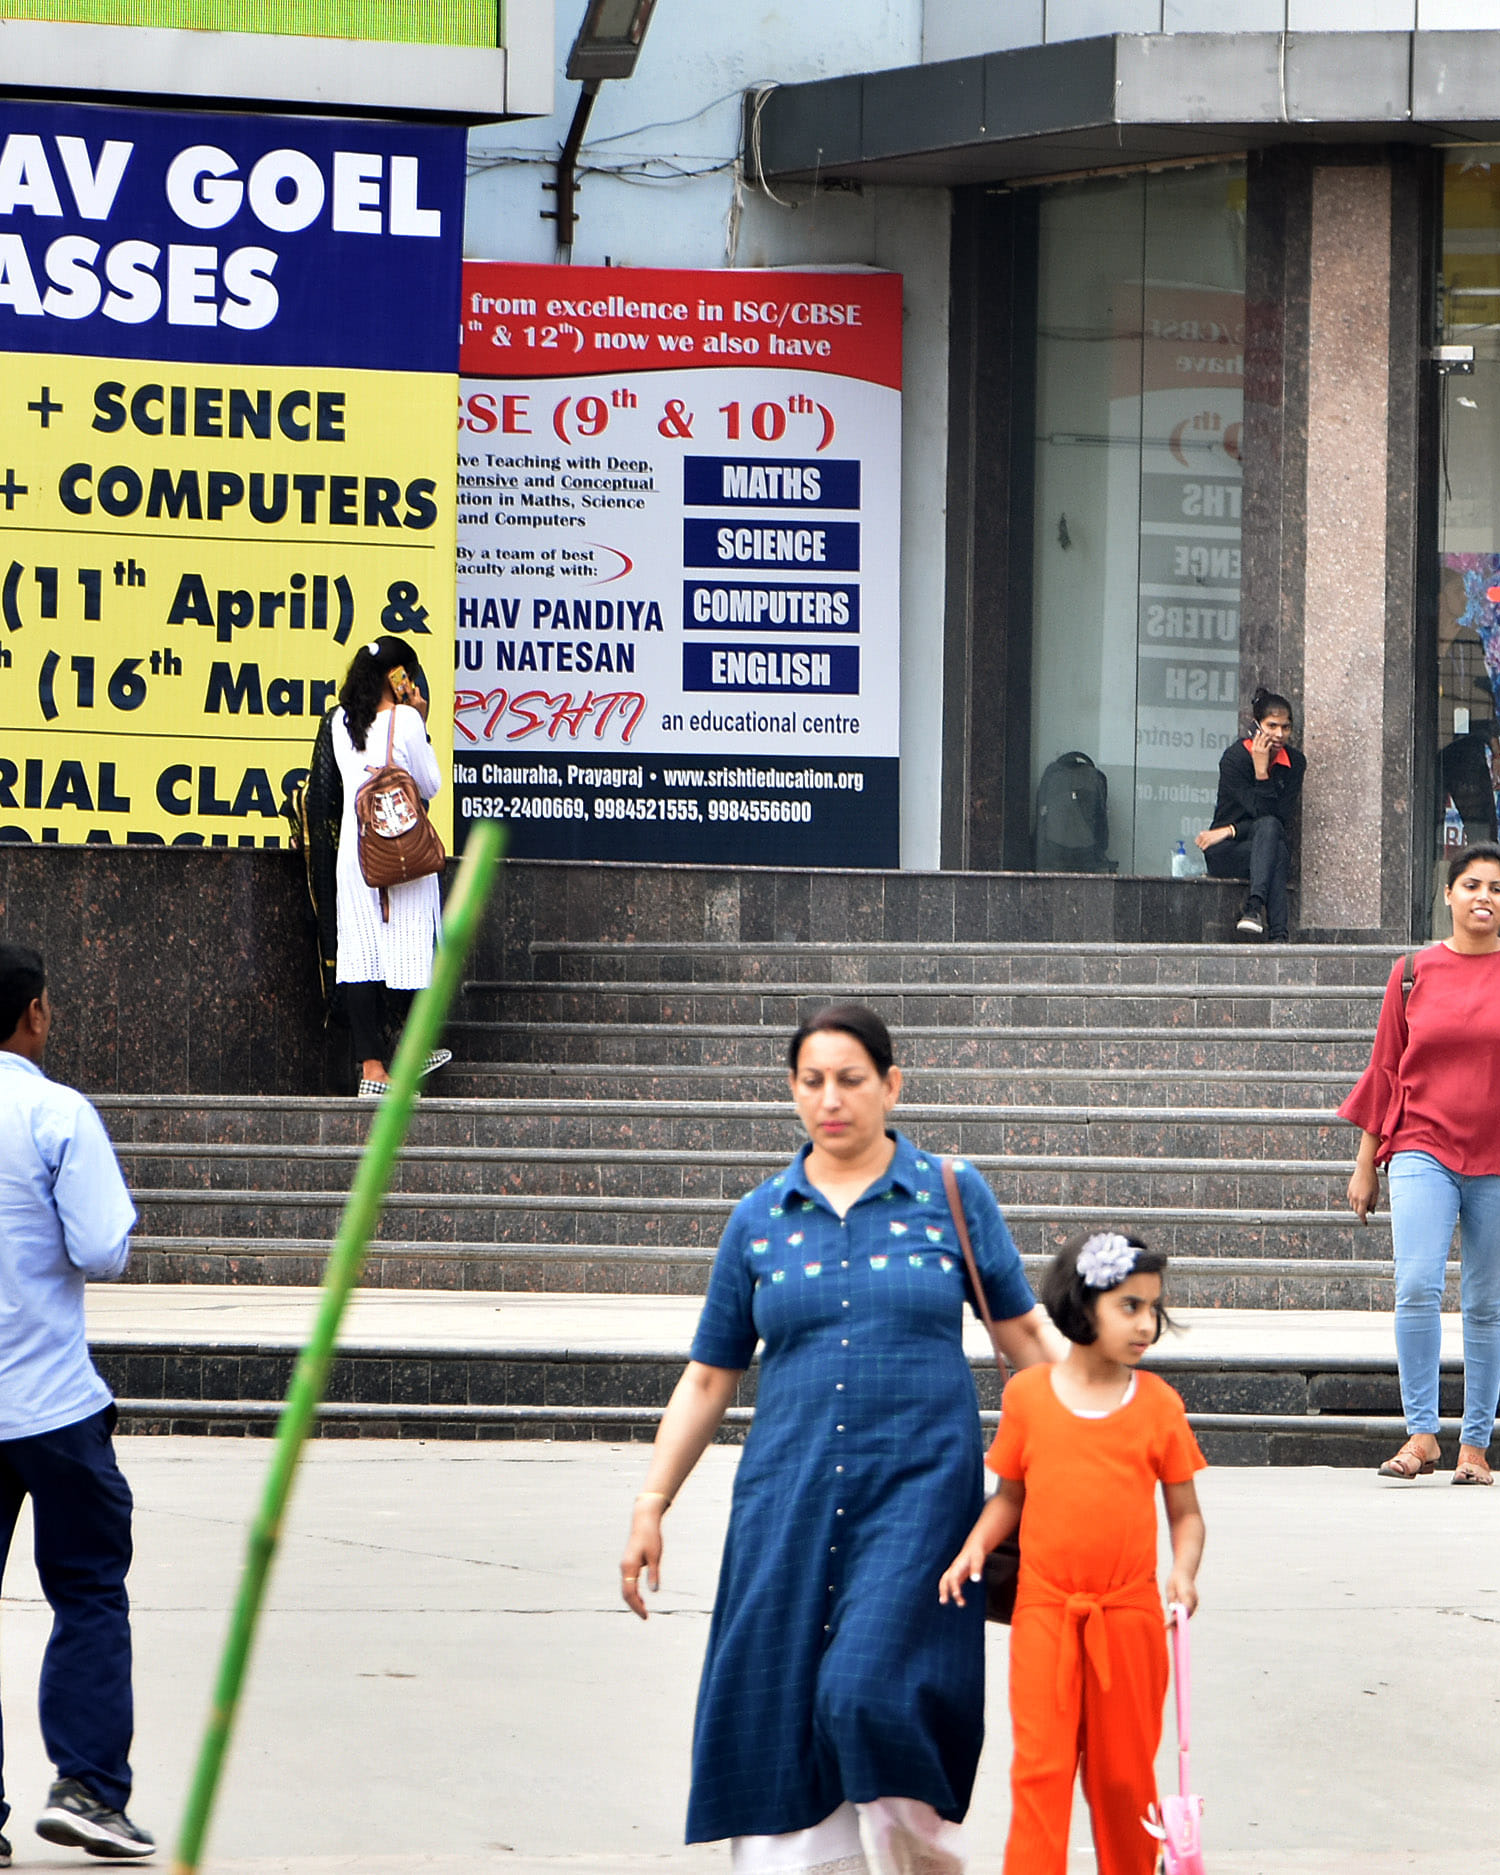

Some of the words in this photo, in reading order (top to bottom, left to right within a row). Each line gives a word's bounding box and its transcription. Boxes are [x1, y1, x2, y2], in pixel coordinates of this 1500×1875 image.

[0, 134, 134, 221] AV
[166, 144, 442, 238] GOEL
[471, 292, 537, 316] from
[547, 296, 688, 320] excellence
[698, 298, 724, 322] in
[733, 300, 863, 328] ISC/CBSE
[491, 325, 512, 347] &
[594, 332, 649, 350] now
[658, 334, 694, 352] we
[703, 332, 760, 354] also
[769, 333, 831, 356] have
[91, 381, 346, 442] SCIENCE
[657, 398, 694, 439] &
[718, 393, 836, 451] 10th)
[485, 454, 562, 471] Teaching
[567, 456, 601, 469] with
[607, 456, 653, 473] Deep,
[58, 463, 437, 530] COMPUTERS
[524, 475, 555, 488] and
[561, 475, 654, 491] Conceptual
[723, 465, 822, 500] MATHS
[456, 493, 492, 506] tion
[499, 493, 515, 507] in
[520, 494, 575, 508] Maths,
[581, 495, 645, 509] Science
[457, 512, 488, 525] and
[495, 512, 586, 528] Computers
[456, 547, 475, 561] By
[481, 550, 490, 560] a
[496, 549, 535, 561] team
[541, 549, 556, 561] of
[562, 550, 594, 562] best
[716, 527, 826, 562] SCIENCE
[455, 562, 505, 576] aculty
[511, 564, 555, 577] along
[560, 564, 598, 577] with:
[167, 573, 354, 645] April)
[380, 580, 432, 634] &
[459, 598, 521, 630] HAV
[533, 599, 664, 632] PANDIYA
[693, 588, 850, 625] COMPUTERS
[497, 640, 635, 673] NATESAN
[711, 651, 831, 686] ENGLISH
[661, 714, 683, 731] an
[689, 711, 796, 733] educational
[802, 715, 860, 734] centre
[482, 764, 562, 786] Chauraha,
[568, 765, 643, 788] Prayagraj
[663, 767, 864, 791] www.srishtieducation.org
[462, 796, 589, 821] 0532-2400669,
[594, 799, 703, 823] 9984521555,
[707, 800, 812, 823] 9984556600
